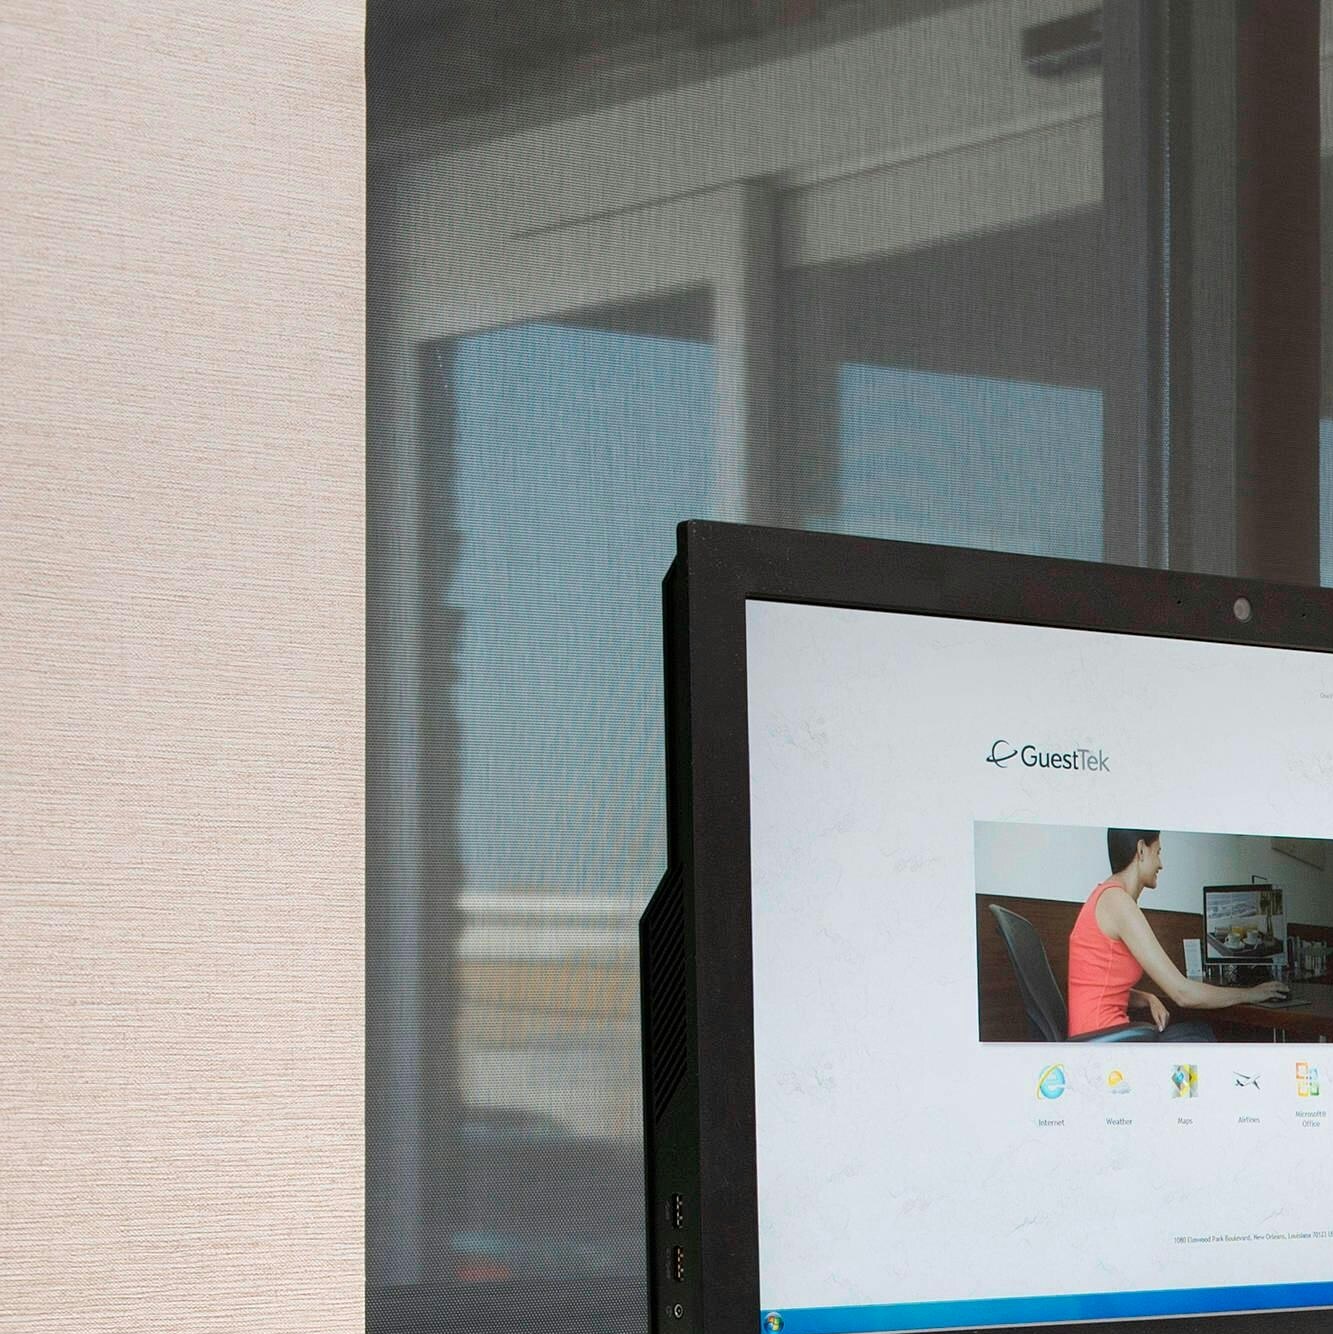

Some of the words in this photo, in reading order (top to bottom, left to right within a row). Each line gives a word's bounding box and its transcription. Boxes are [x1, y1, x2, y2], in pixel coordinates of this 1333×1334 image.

[1021, 744, 1111, 772] GuestTek
[1038, 1118, 1065, 1127] Internet
[1105, 1117, 1133, 1126] Weather
[1177, 1117, 1193, 1126] Maps
[1237, 1115, 1260, 1124] Airlines
